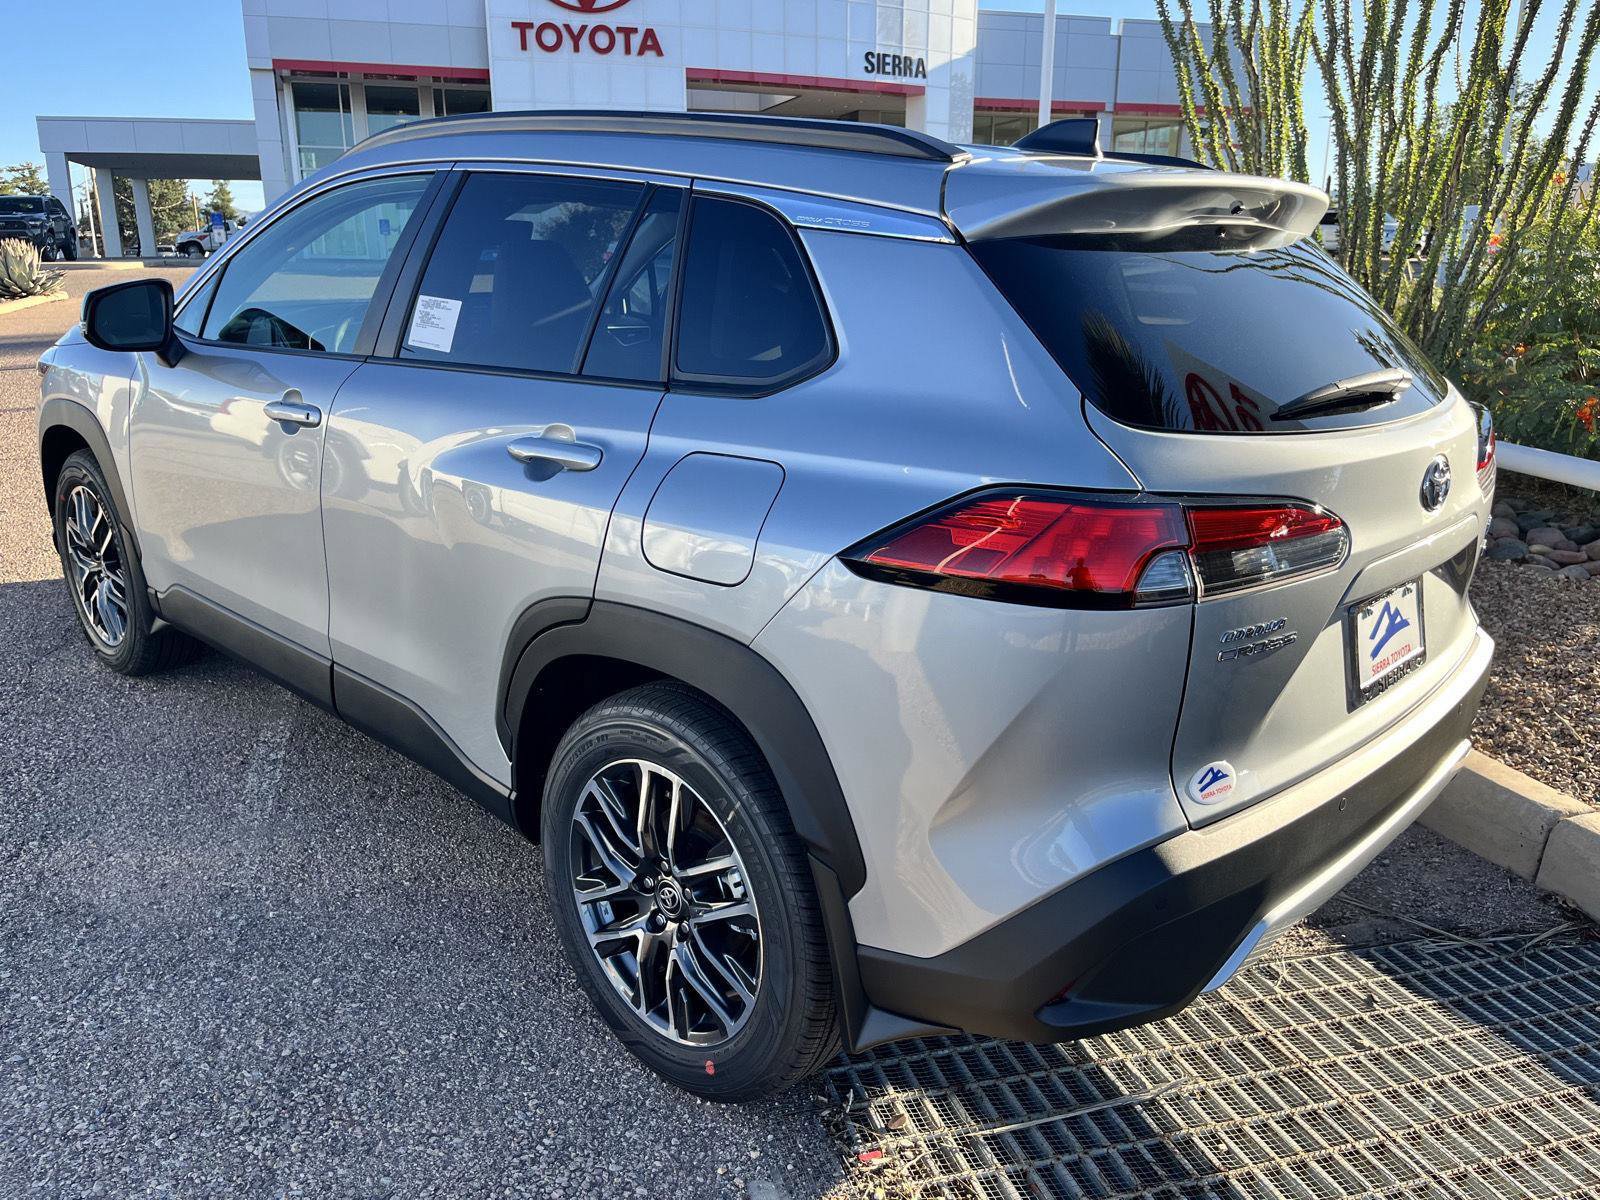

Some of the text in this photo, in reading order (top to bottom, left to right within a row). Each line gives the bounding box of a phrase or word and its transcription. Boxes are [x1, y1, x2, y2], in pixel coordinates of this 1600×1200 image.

[511, 21, 664, 57] TOYOTA
[864, 51, 927, 79] SIERRA
[1371, 643, 1411, 677] SIERRA TOYOTA
